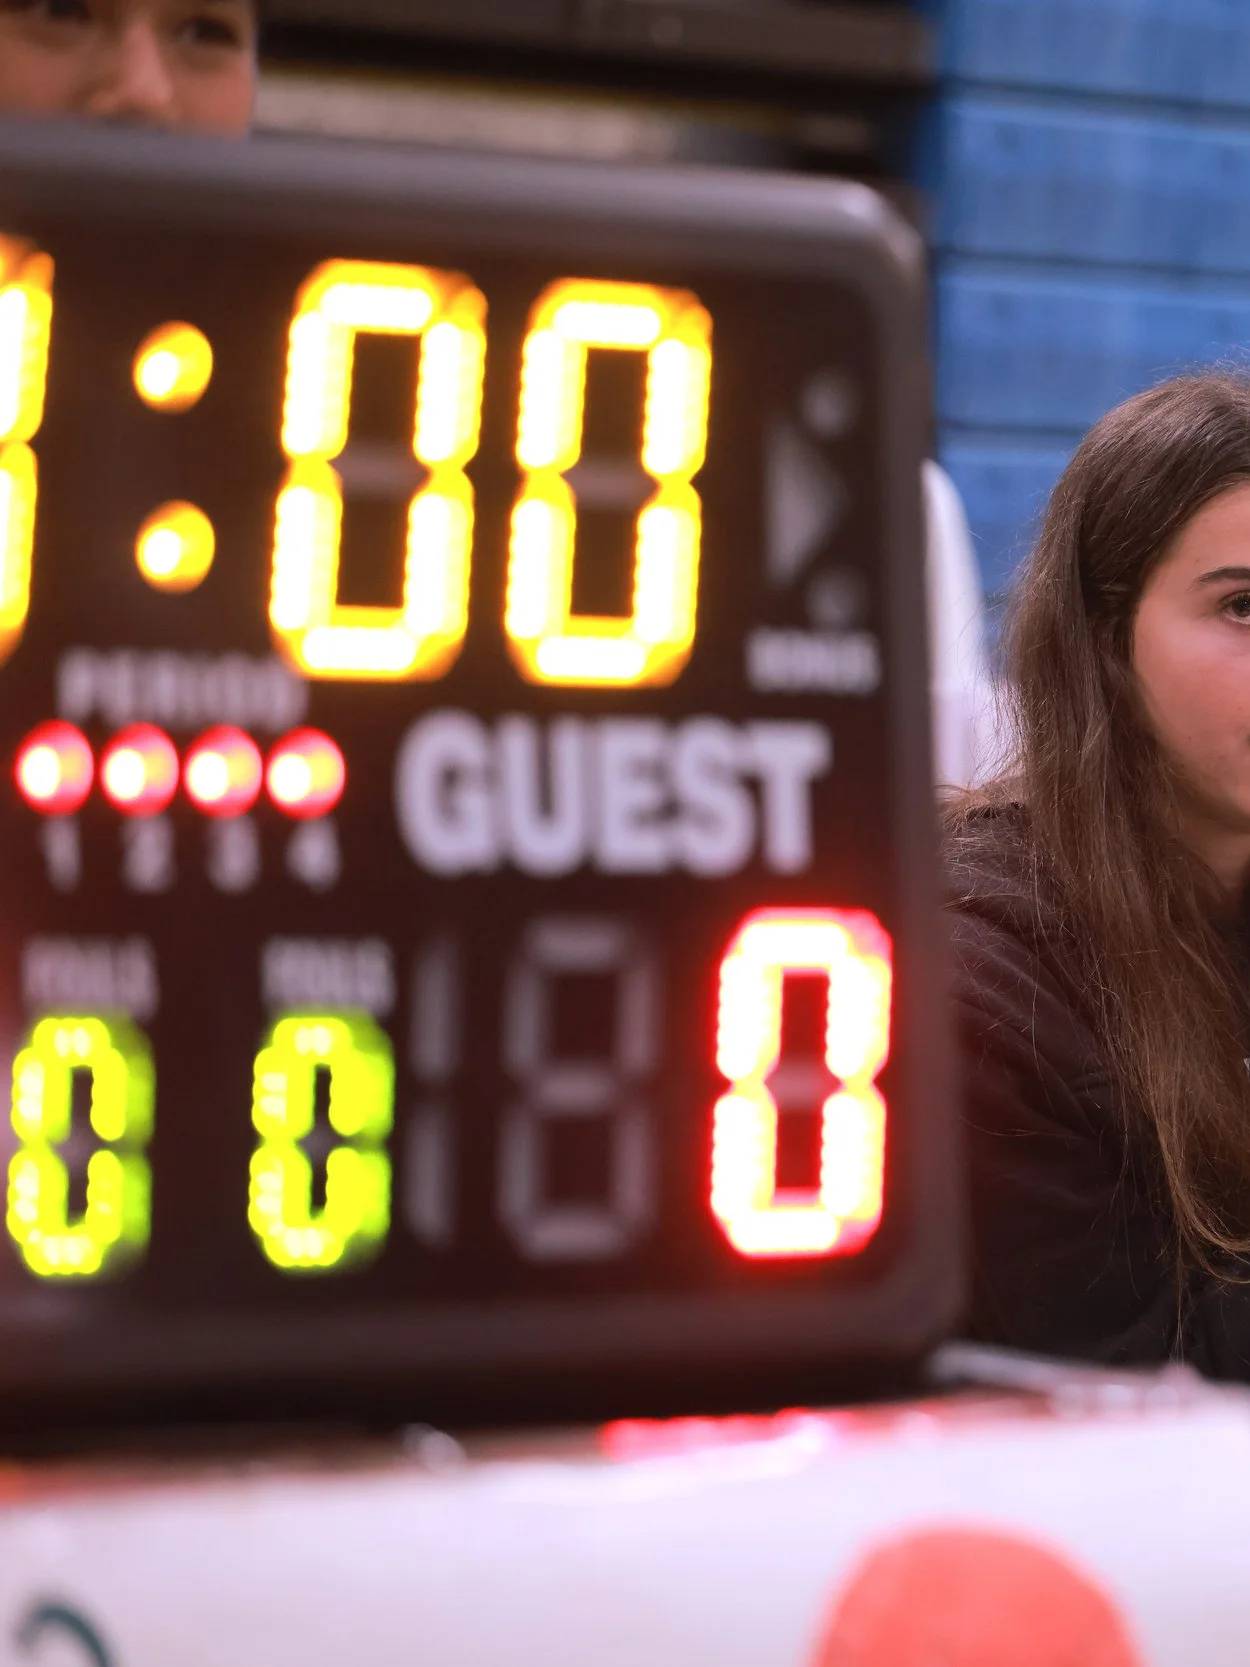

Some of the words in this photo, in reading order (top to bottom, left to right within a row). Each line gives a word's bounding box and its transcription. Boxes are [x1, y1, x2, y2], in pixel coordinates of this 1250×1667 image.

[394, 708, 832, 878] GUEST
[7, 1015, 153, 1277] 0
[248, 1015, 395, 1268] 0
[710, 908, 893, 1260] 0
